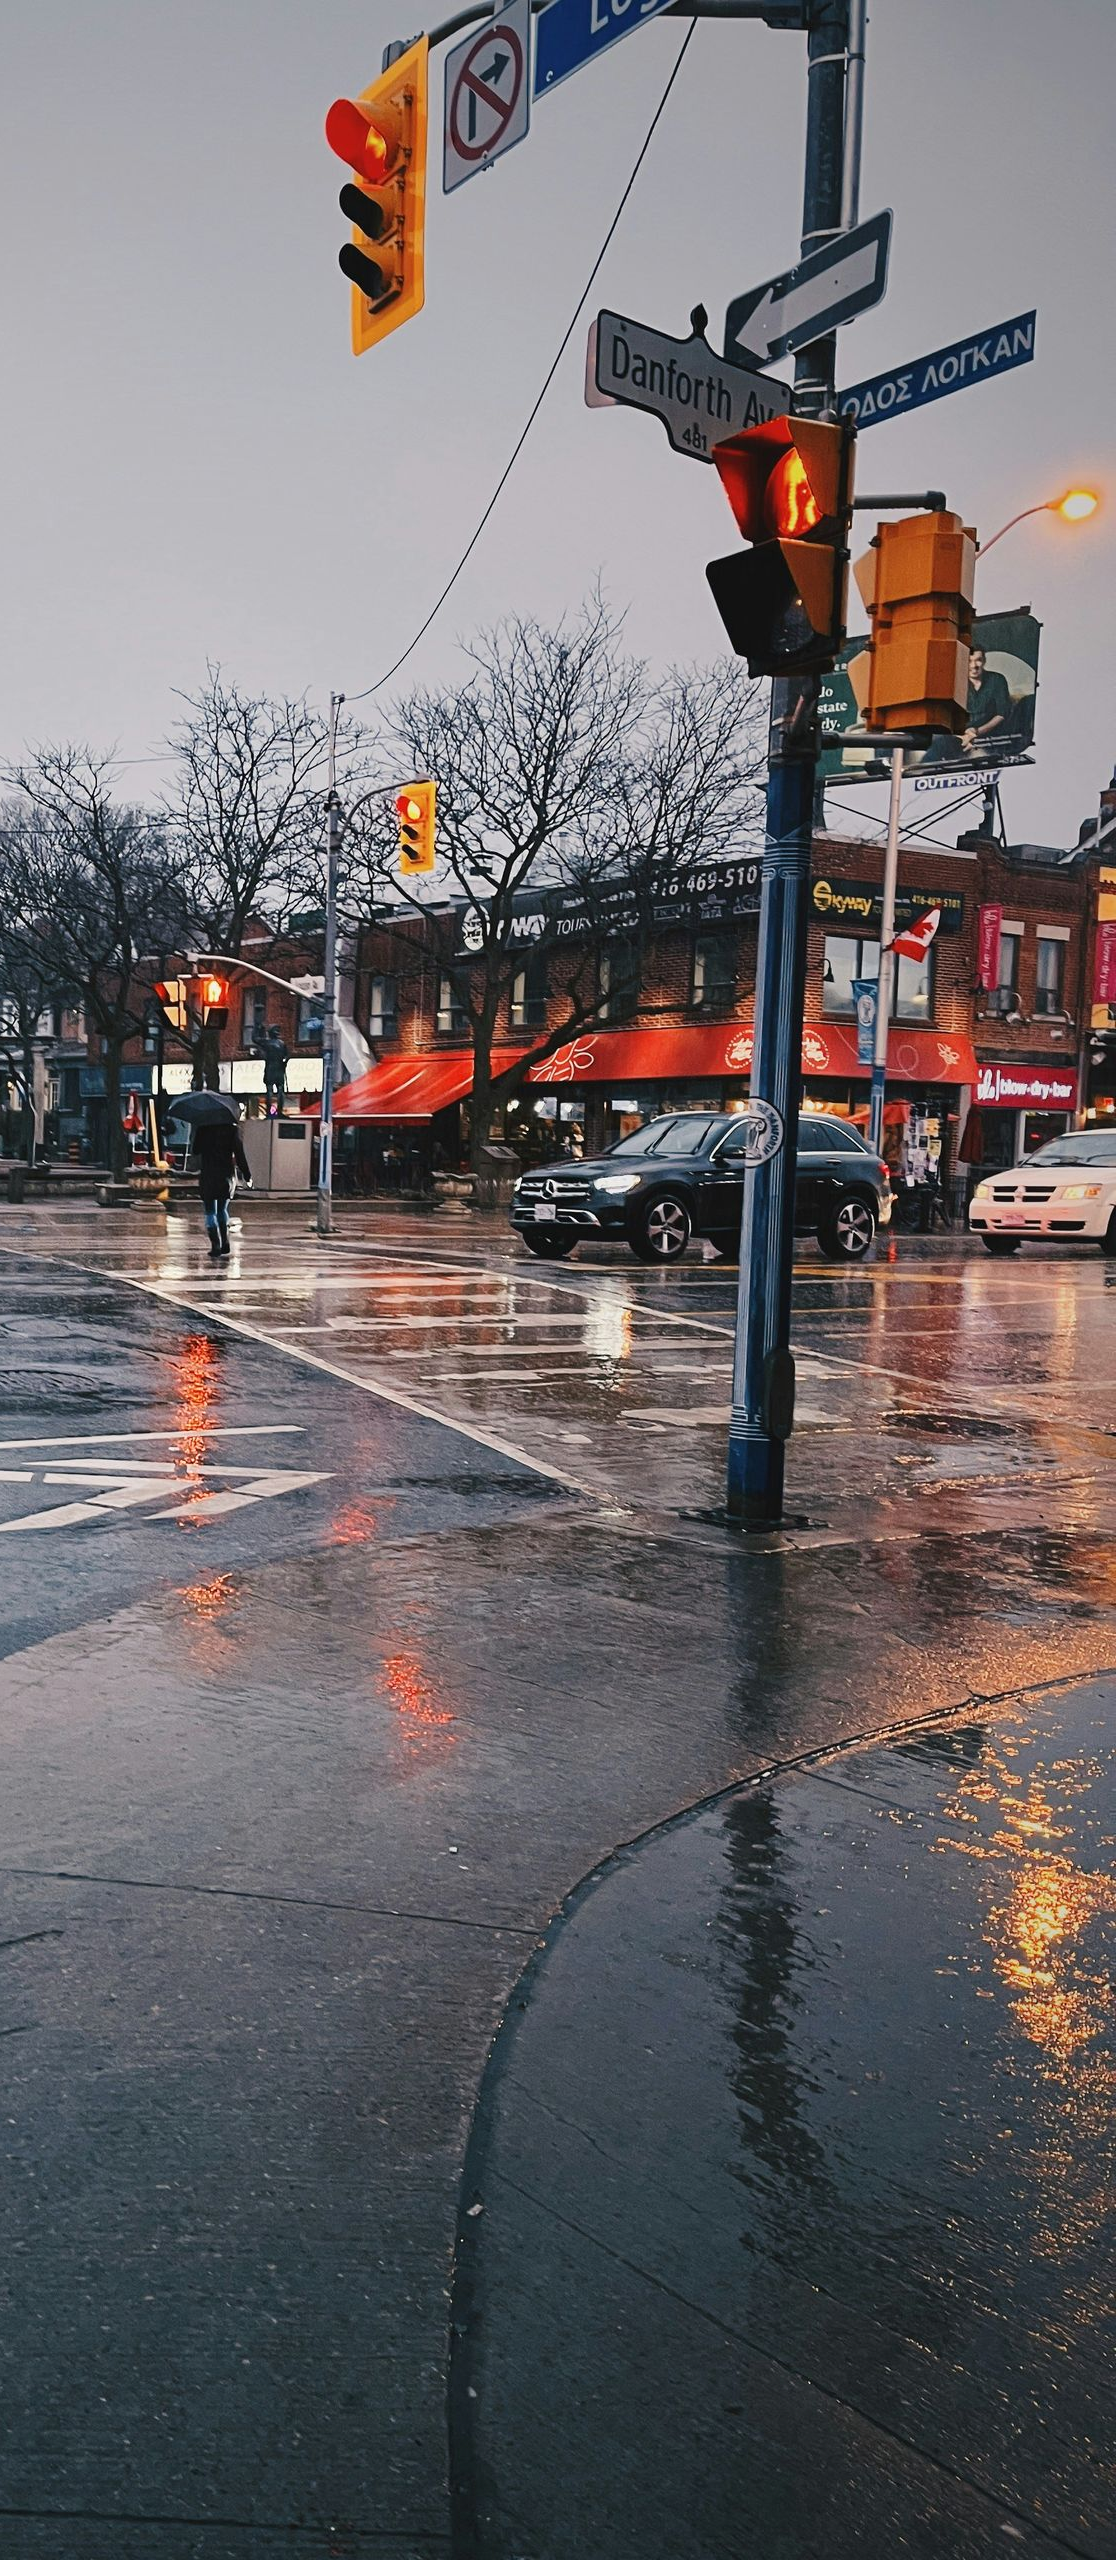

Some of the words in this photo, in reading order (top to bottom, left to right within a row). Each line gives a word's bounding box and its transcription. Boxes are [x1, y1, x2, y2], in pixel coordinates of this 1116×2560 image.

[612, 335, 732, 422] Danforth
[921, 324, 1033, 393] ΛΟΓΚΑΝ
[682, 428, 708, 452] 481
[916, 771, 998, 791] OUTFRONT
